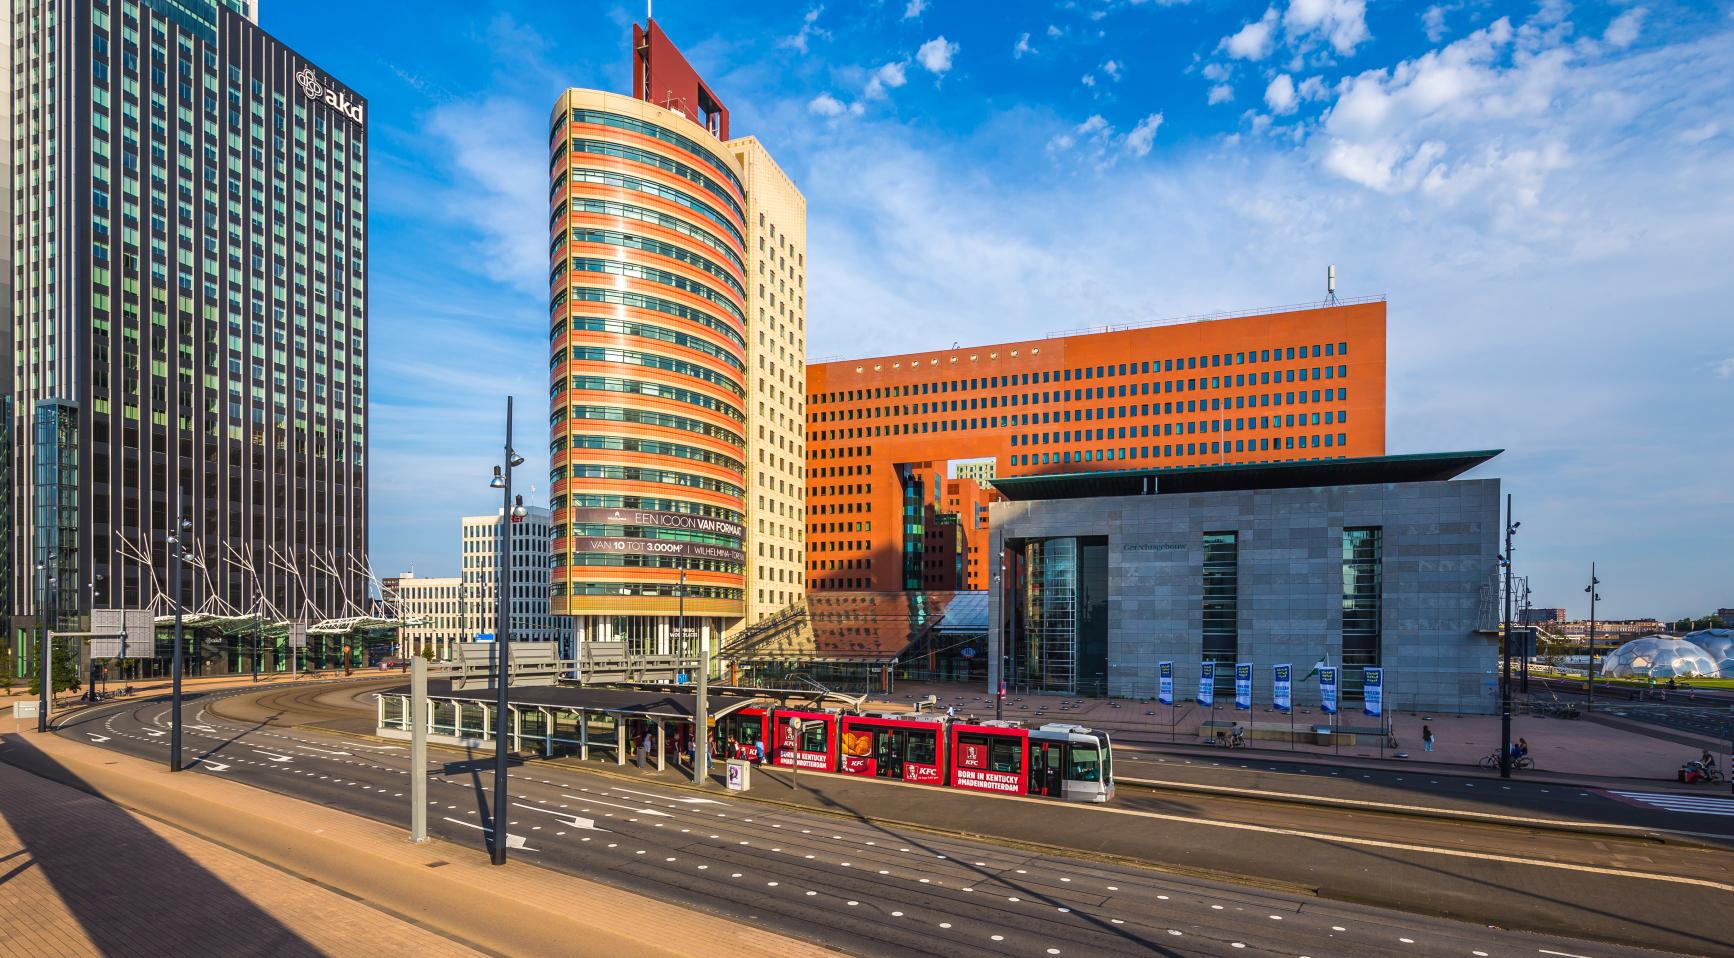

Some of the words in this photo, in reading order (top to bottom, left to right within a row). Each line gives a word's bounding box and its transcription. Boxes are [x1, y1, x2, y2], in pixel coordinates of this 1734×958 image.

[325, 88, 363, 124] akd
[635, 512, 659, 524] EEN
[660, 515, 695, 528] ICOON
[697, 518, 715, 531] VAN
[590, 540, 611, 549] VAN
[613, 541, 625, 550] 10
[627, 541, 645, 551] TOT
[801, 753, 827, 762] KENTUCKY
[919, 767, 937, 776] KFC
[957, 770, 976, 779] BORN
[977, 772, 984, 781] IN
[986, 773, 1019, 784] KENTUCKY
[957, 778, 1019, 792] #MADEINROTTERDAM
